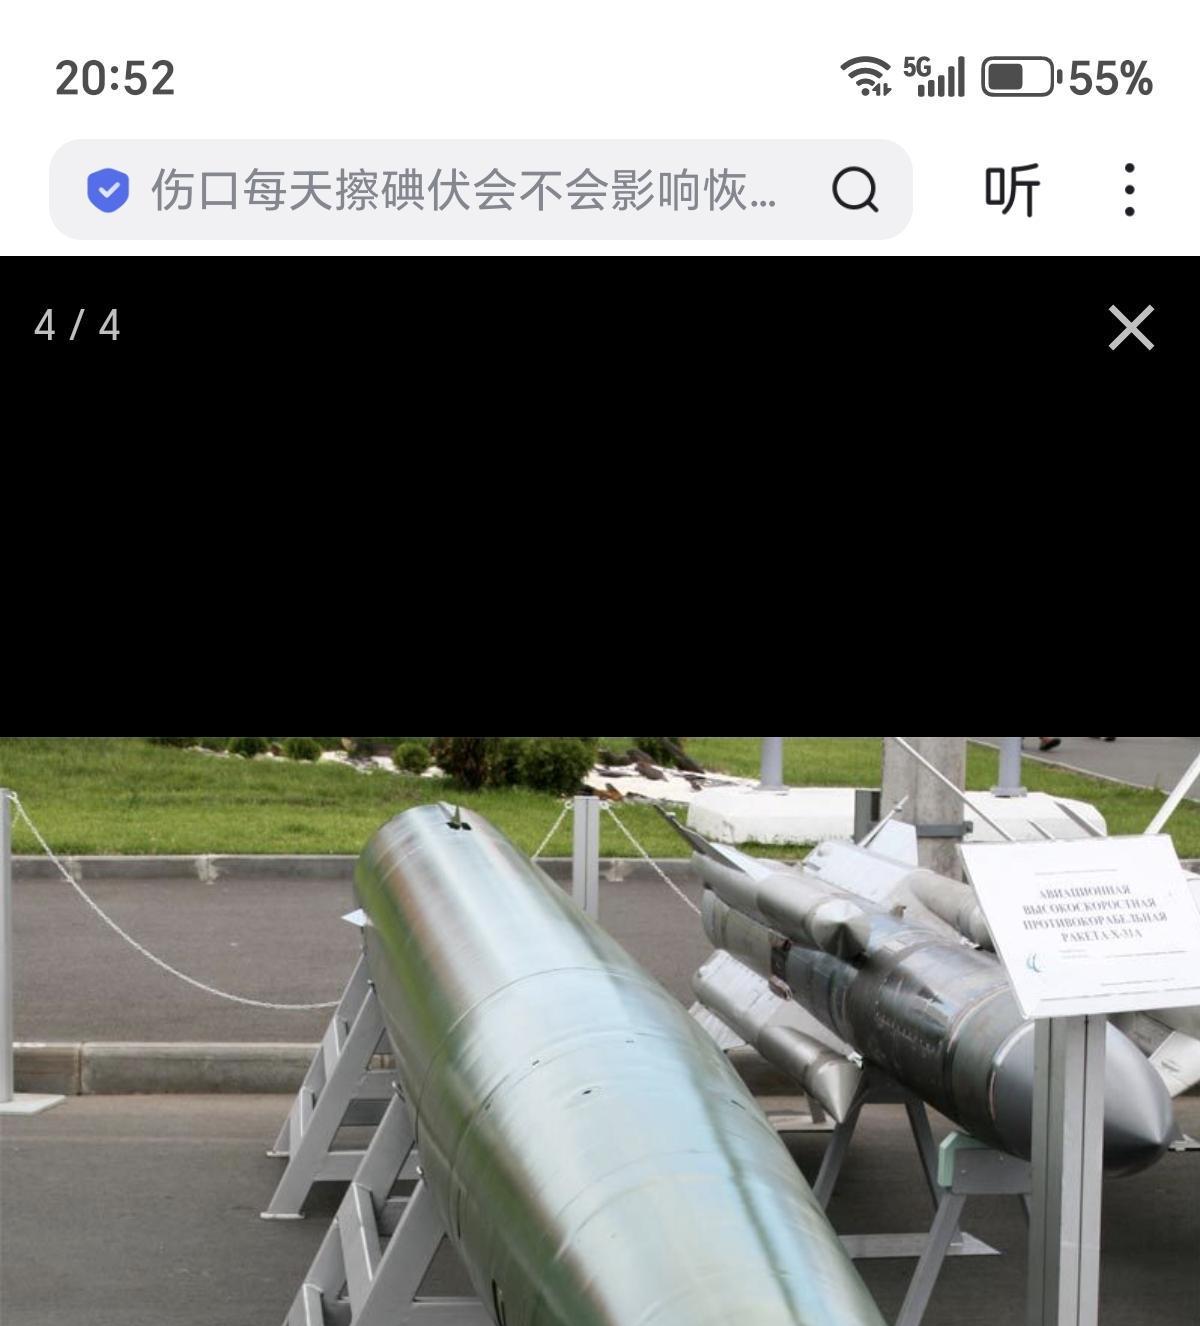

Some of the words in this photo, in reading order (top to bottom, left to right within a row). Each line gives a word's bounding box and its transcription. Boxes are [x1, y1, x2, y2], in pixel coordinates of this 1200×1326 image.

[55, 59, 175, 96] 20:52
[903, 55, 932, 78] 5G
[1069, 59, 1154, 96] 55%
[985, 162, 1041, 218] 听
[34, 308, 56, 341] 4
[98, 308, 120, 341] 4
[1040, 885, 1131, 899] АВИАЦИОННАЯ
[1022, 897, 1157, 915] ВЫСОКОСКОРОСТНАЯ
[1022, 911, 1168, 930] ПРОТИВОКОРАБЕЛЬНАЯ
[1061, 930, 1109, 942] РАКЕТА
